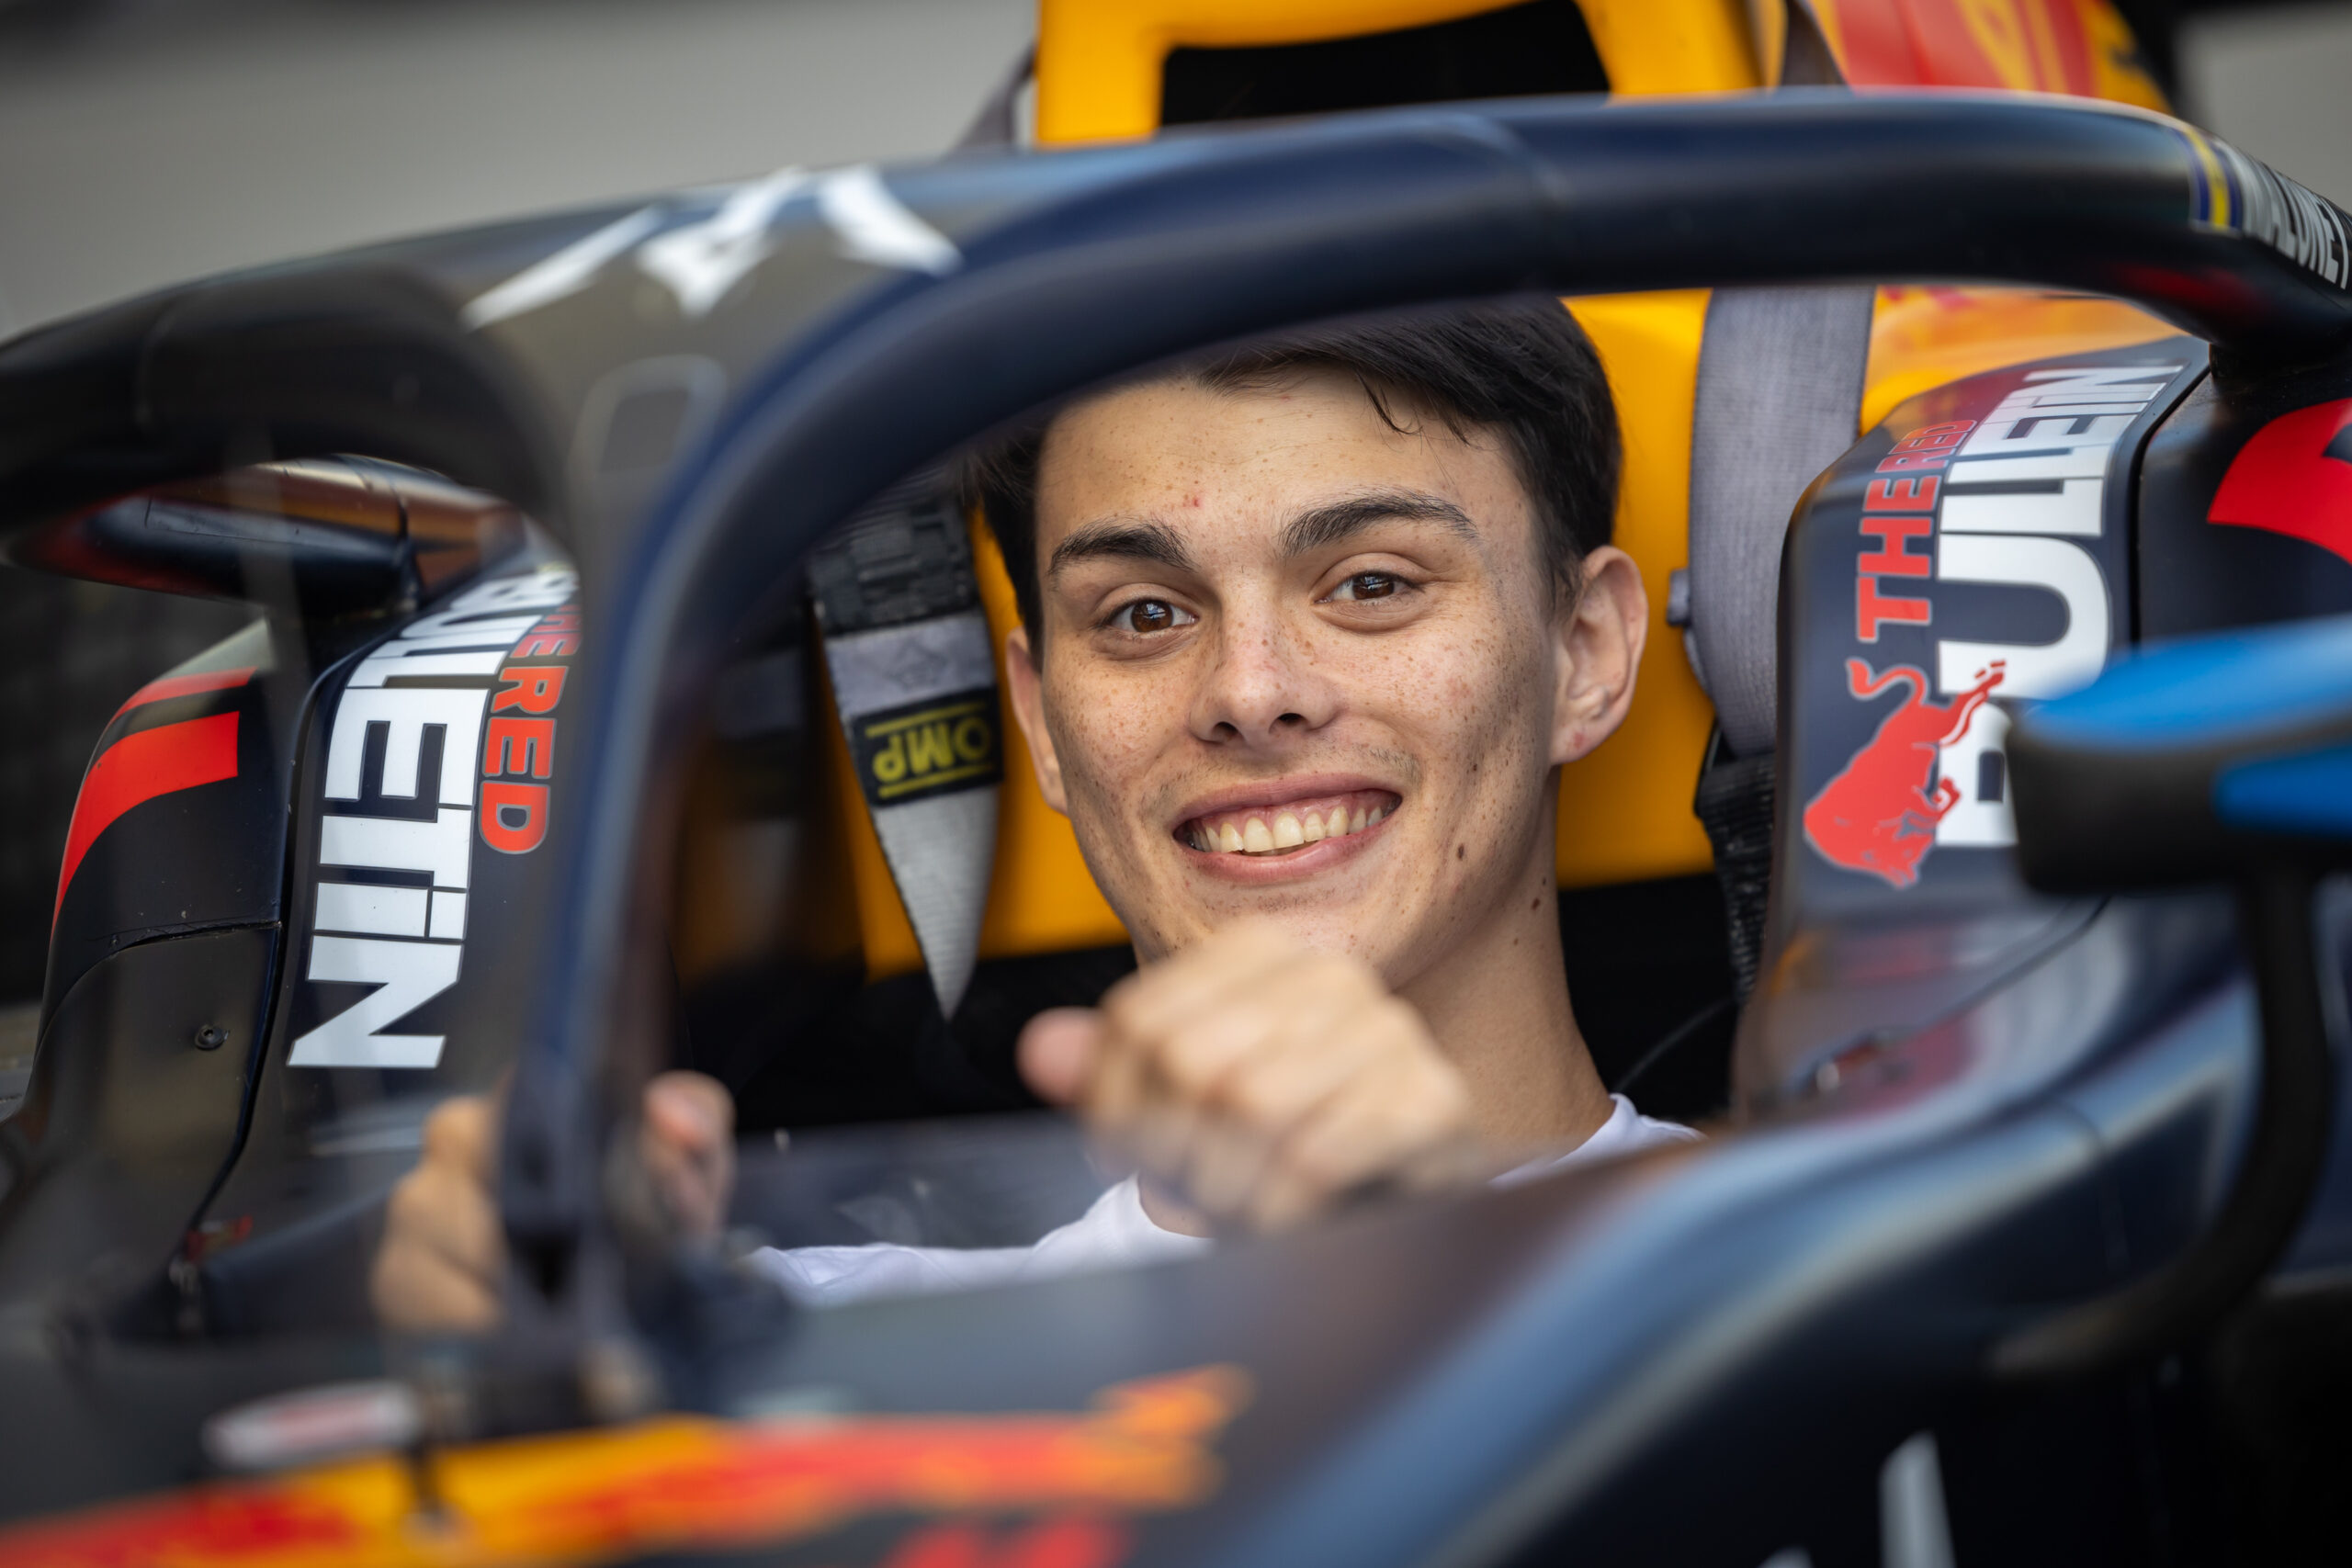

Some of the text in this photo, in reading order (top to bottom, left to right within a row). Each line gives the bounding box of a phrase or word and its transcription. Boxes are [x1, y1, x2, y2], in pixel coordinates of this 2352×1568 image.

[1857, 419, 1978, 643] THE RED
[480, 665, 571, 855] RED
[872, 716, 992, 784] OMP
